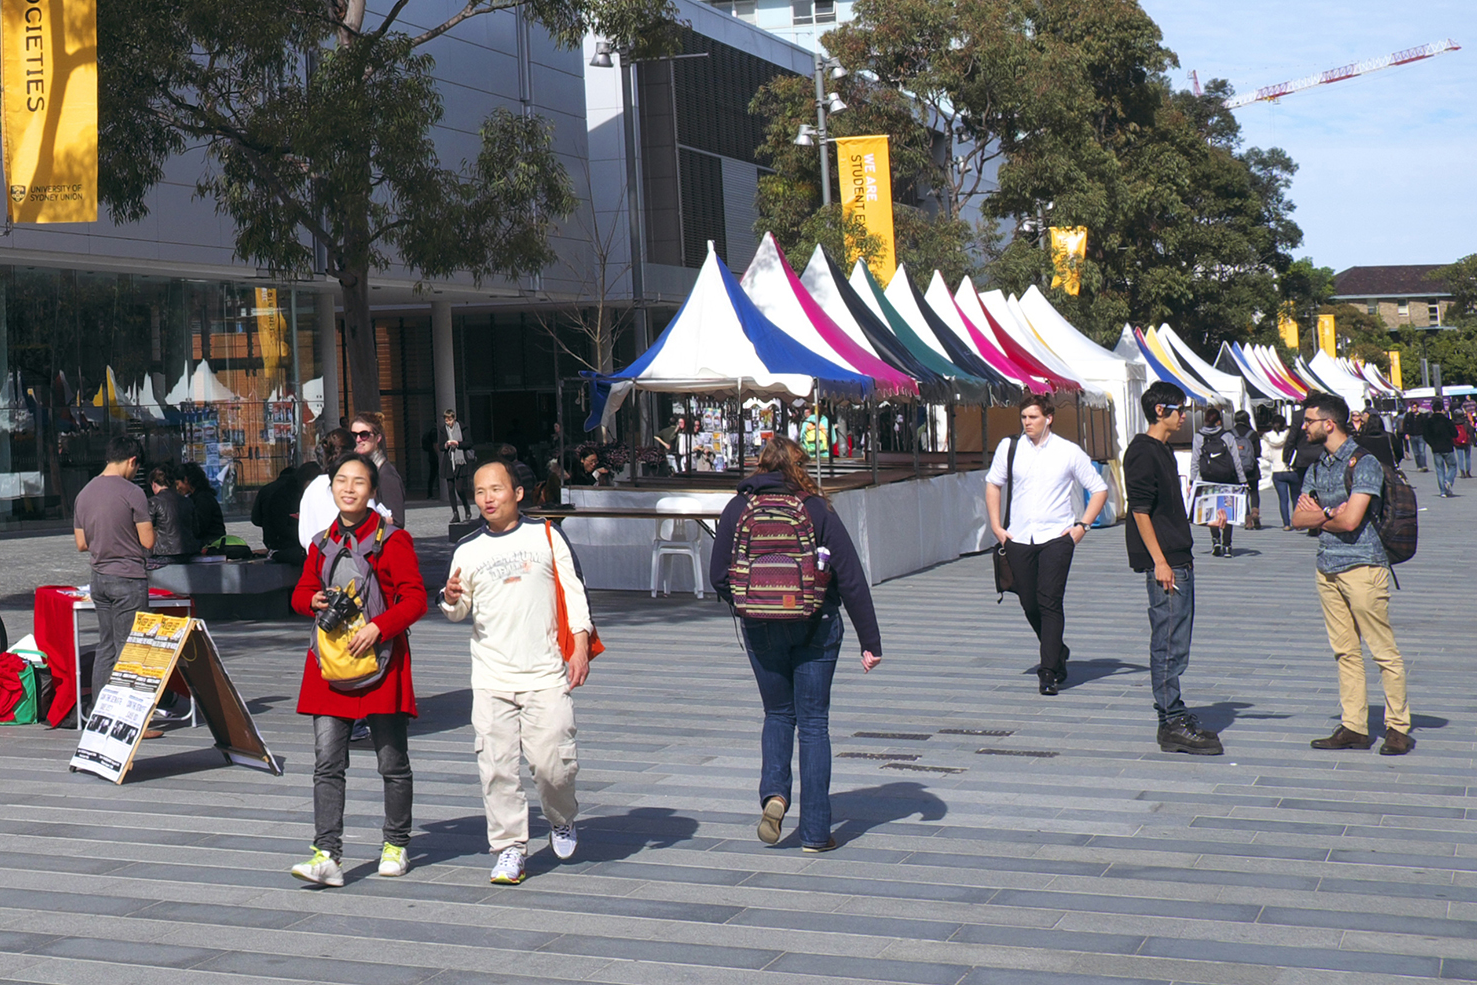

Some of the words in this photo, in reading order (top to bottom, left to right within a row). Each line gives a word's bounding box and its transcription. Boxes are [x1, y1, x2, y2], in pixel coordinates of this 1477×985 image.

[864, 153, 876, 173] WE
[30, 184, 71, 194] UNIVERSITY
[71, 183, 83, 192] OF
[851, 154, 865, 210] STUDENT
[865, 176, 878, 202] ARE
[30, 193, 59, 202] SYDNEY
[60, 192, 83, 201] UNION
